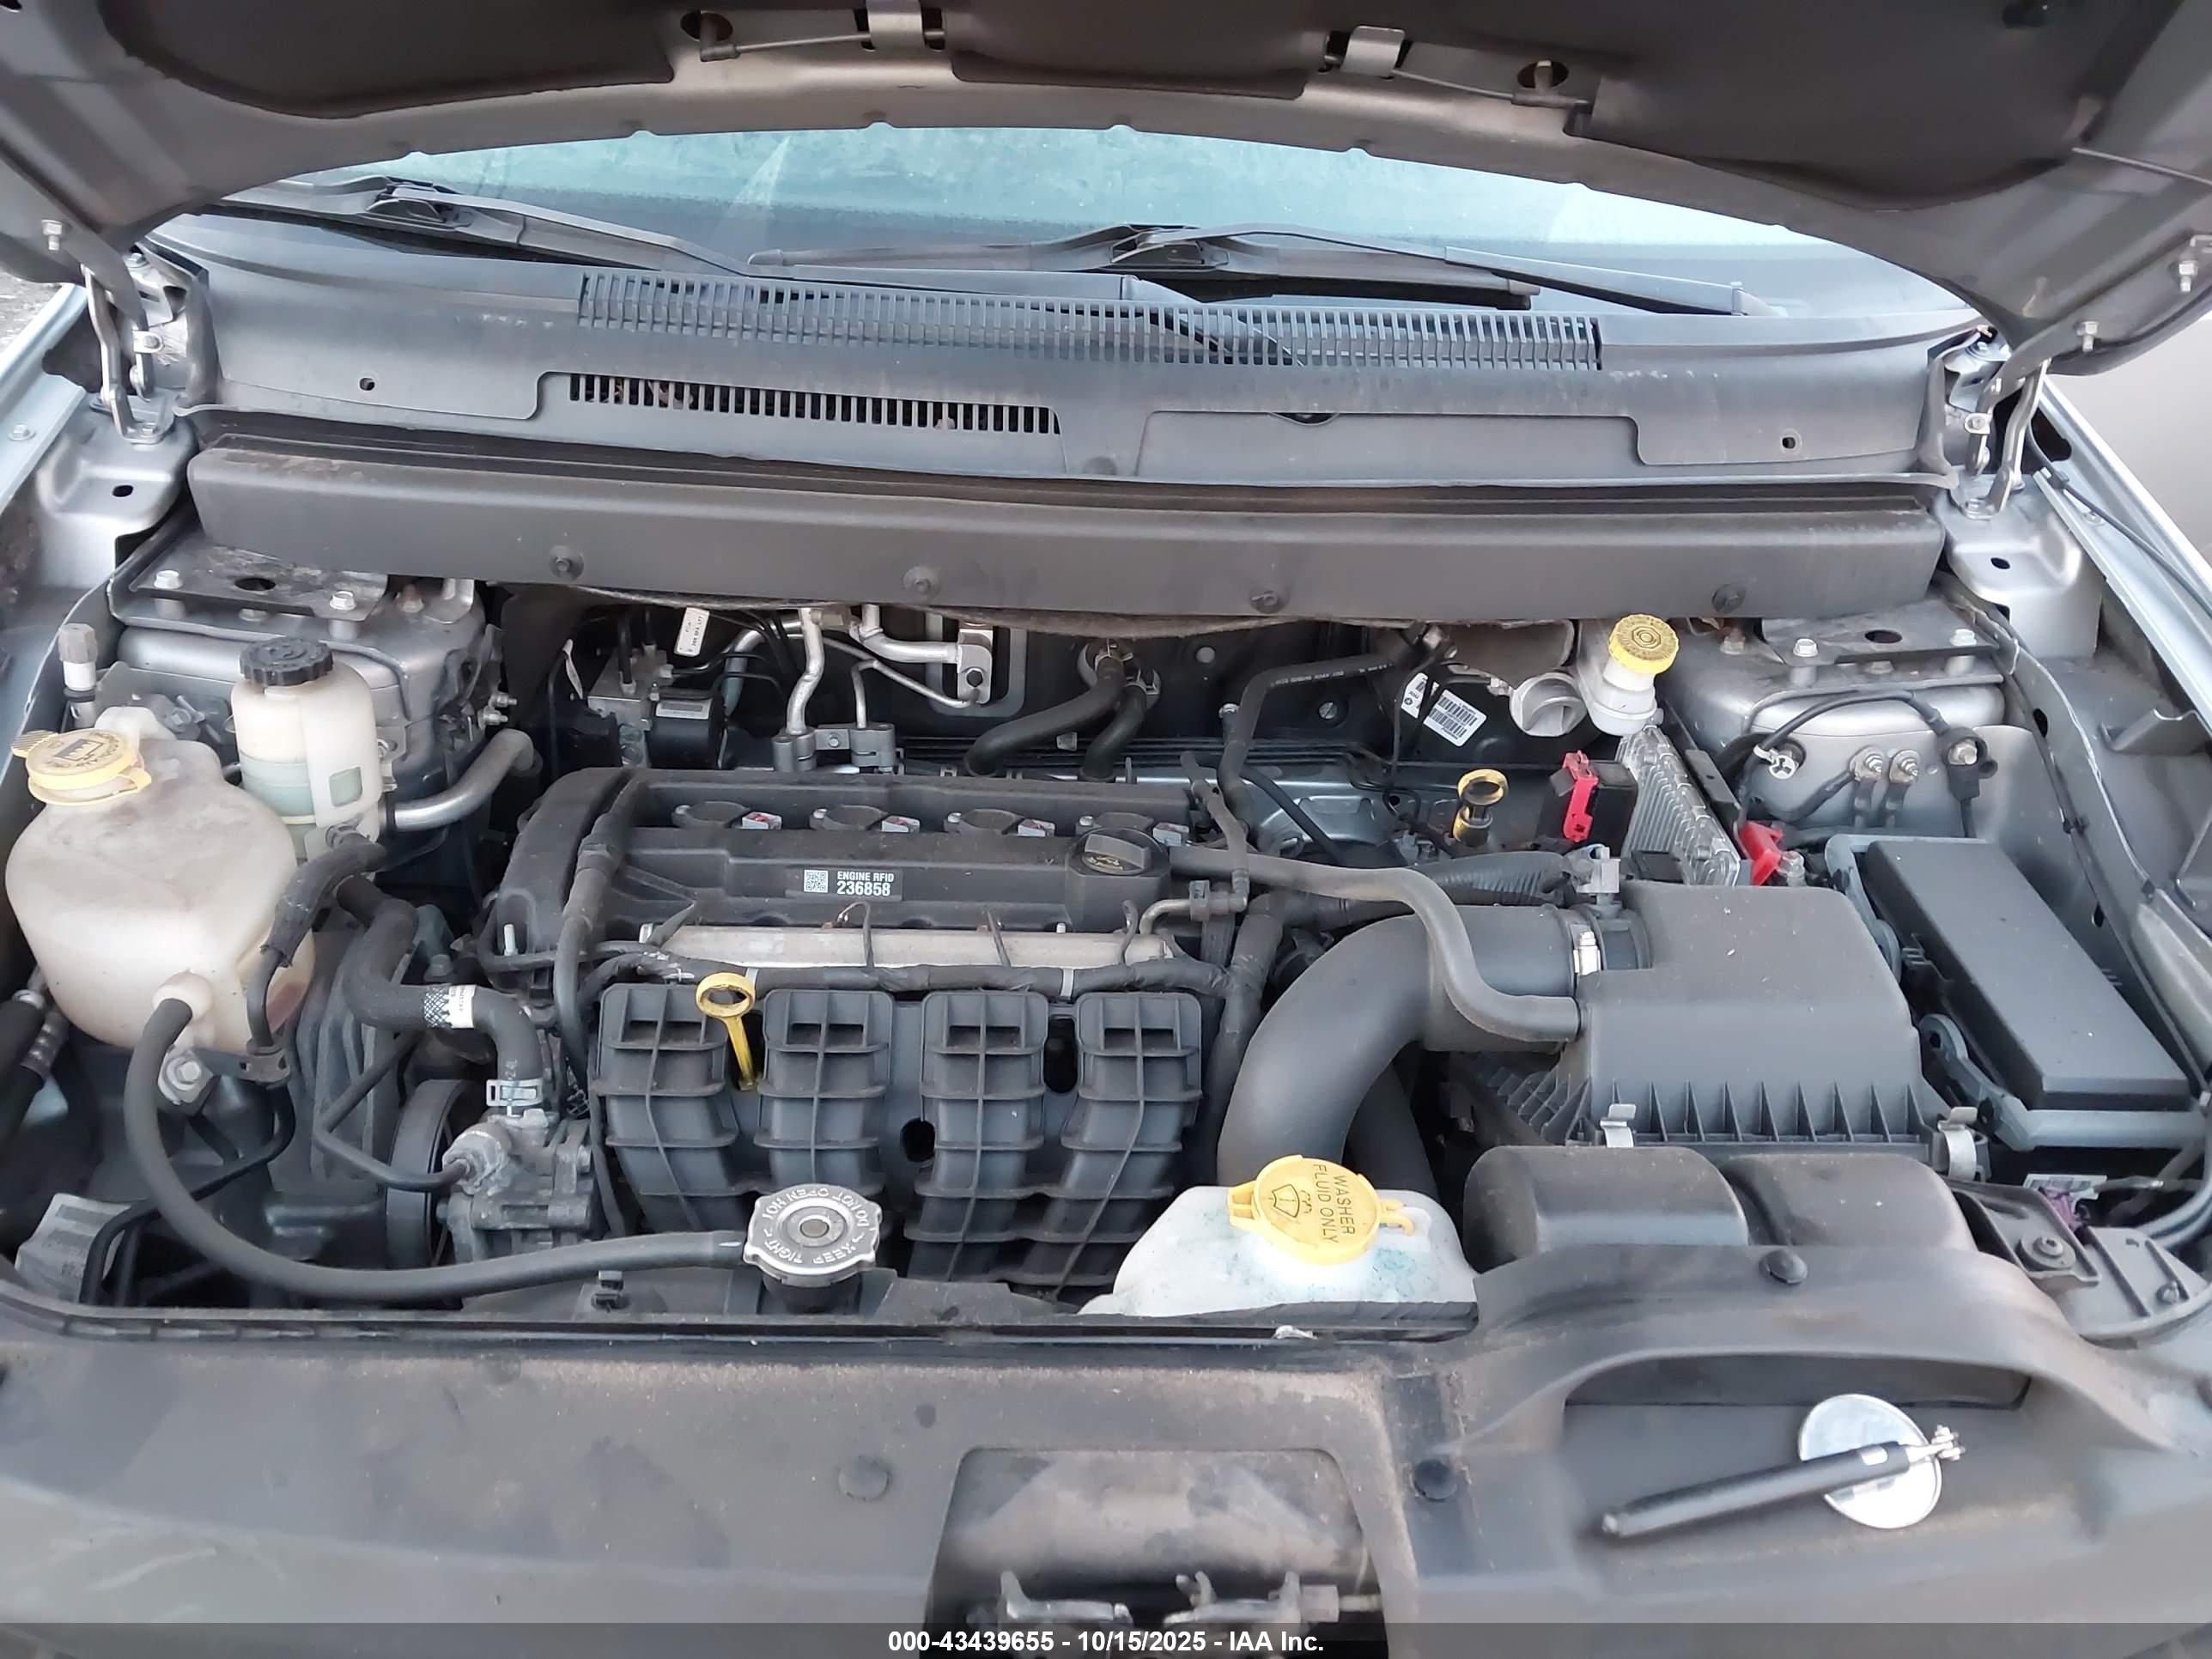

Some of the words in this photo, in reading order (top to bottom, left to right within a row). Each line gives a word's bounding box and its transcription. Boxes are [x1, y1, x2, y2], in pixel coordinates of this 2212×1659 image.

[837, 871, 871, 881] ENGINE
[872, 872, 895, 883] RFID
[836, 881, 891, 896] 236858
[1312, 1164, 1332, 1203] FLUID
[787, 1188, 830, 1202] OPEN
[832, 1193, 861, 1211] NOT
[1333, 1176, 1356, 1235] WASHER
[762, 1196, 787, 1219] HOT
[855, 1212, 870, 1227] DO
[1319, 1207, 1339, 1243] ONLY
[763, 1238, 804, 1264] TIGHT
[812, 1243, 857, 1264] KEEP
